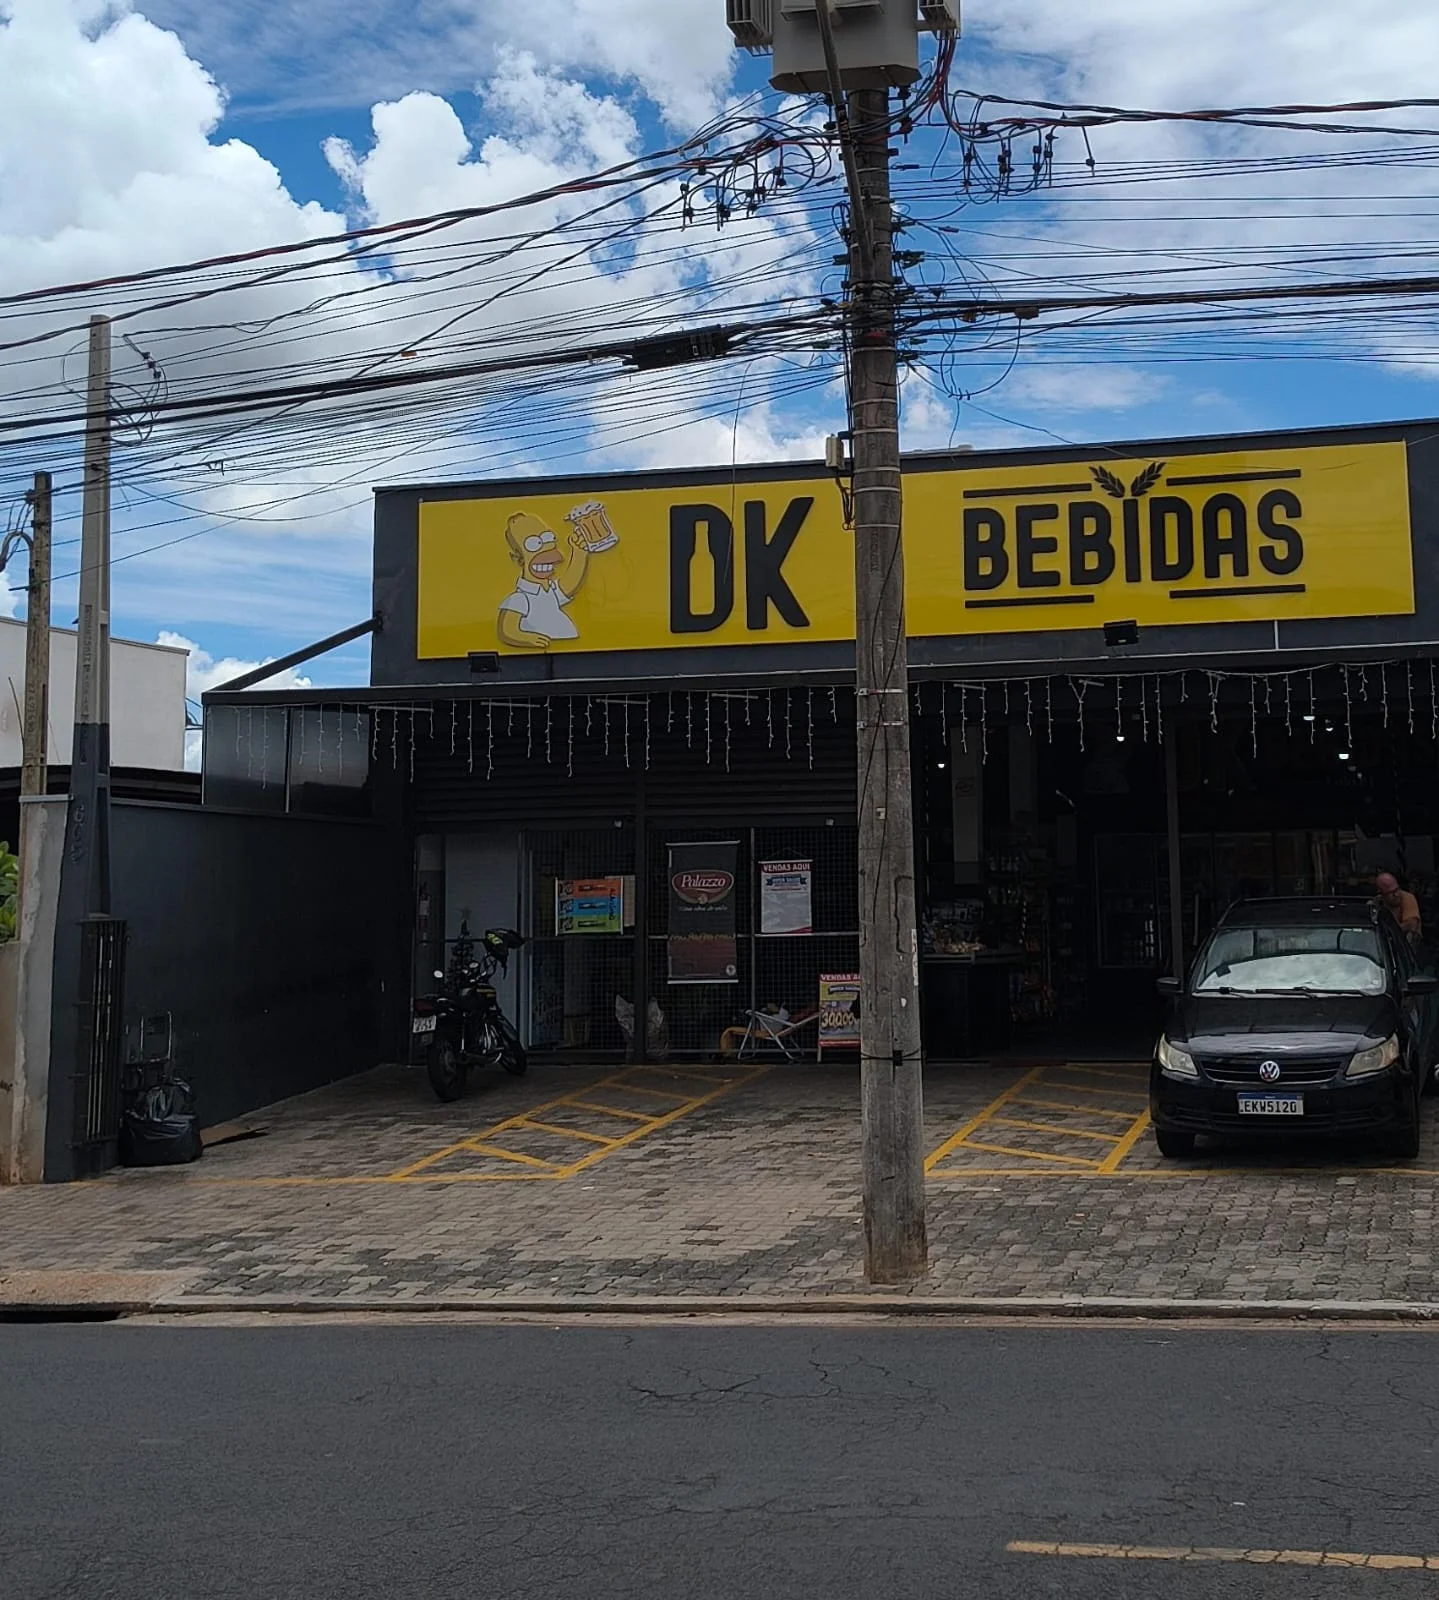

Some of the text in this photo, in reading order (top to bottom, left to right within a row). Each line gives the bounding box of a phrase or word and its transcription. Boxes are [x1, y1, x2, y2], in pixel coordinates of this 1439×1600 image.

[670, 497, 814, 634] DK
[964, 489, 1303, 590] BEBIDAS
[681, 875, 726, 888] Palazzo
[763, 862, 810, 872] VENDAS AQUI
